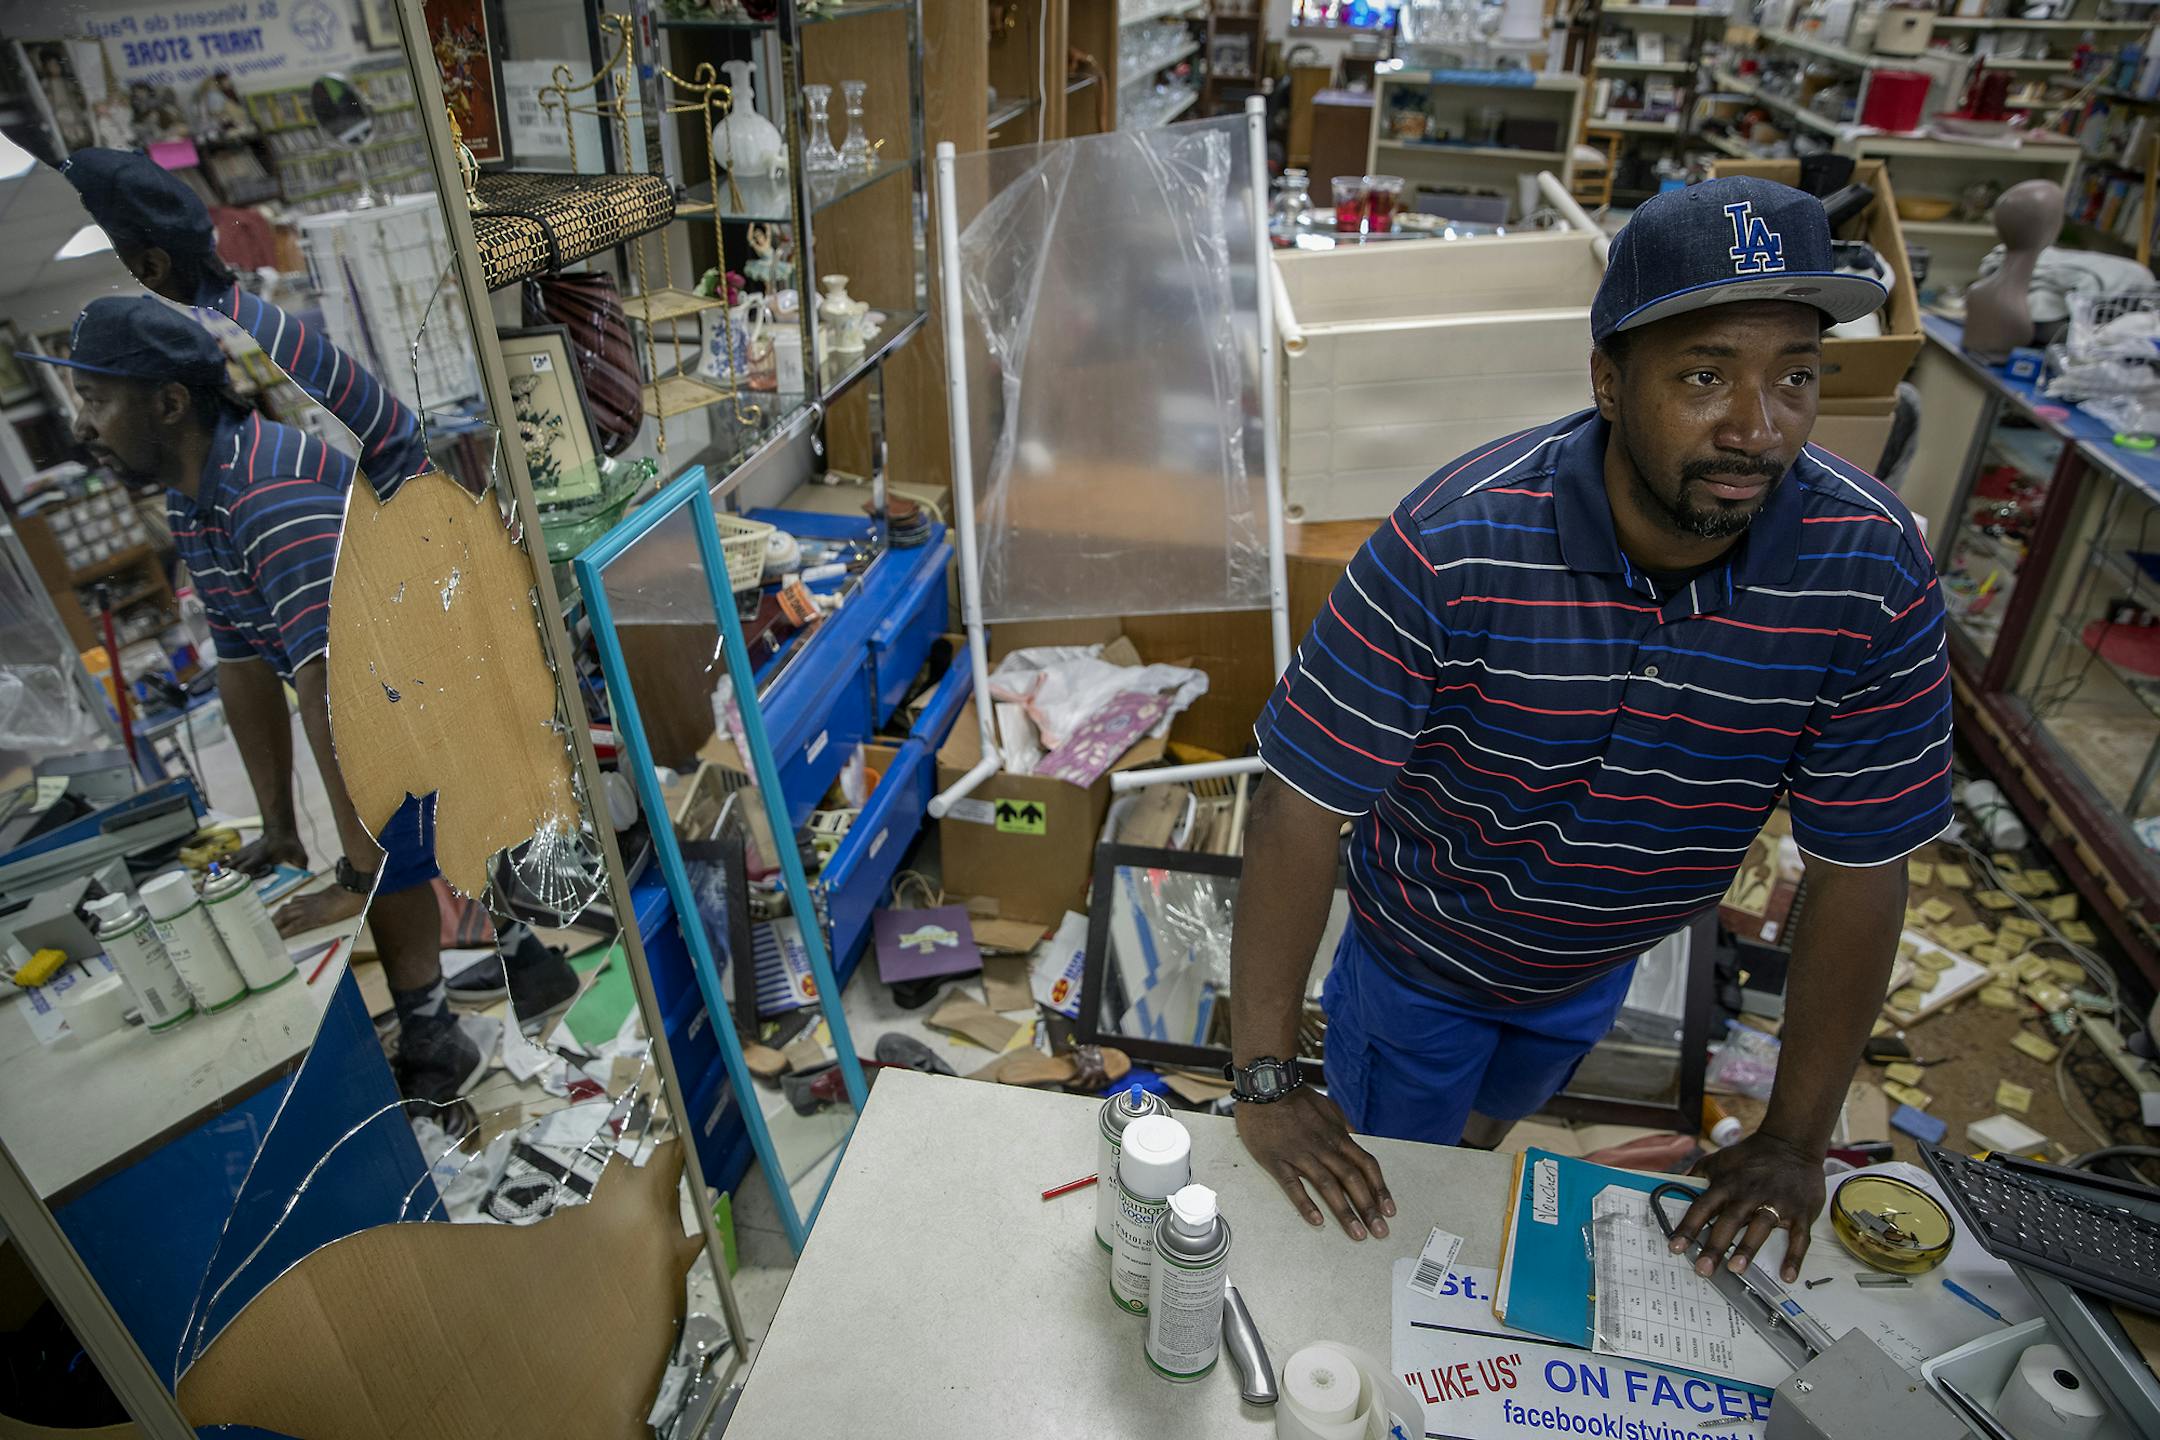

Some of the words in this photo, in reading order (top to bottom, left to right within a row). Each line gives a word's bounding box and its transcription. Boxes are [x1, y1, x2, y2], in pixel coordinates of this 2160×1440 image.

[1724, 200, 1786, 274] LA
[1119, 1192, 1166, 1215] Diamon
[1120, 1203, 1155, 1225] Vogel
[1440, 1272, 1489, 1301] St.
[1404, 1363, 1480, 1405] "LIKE
[1477, 1353, 1522, 1393] US"
[1544, 1359, 1610, 1400] ON
